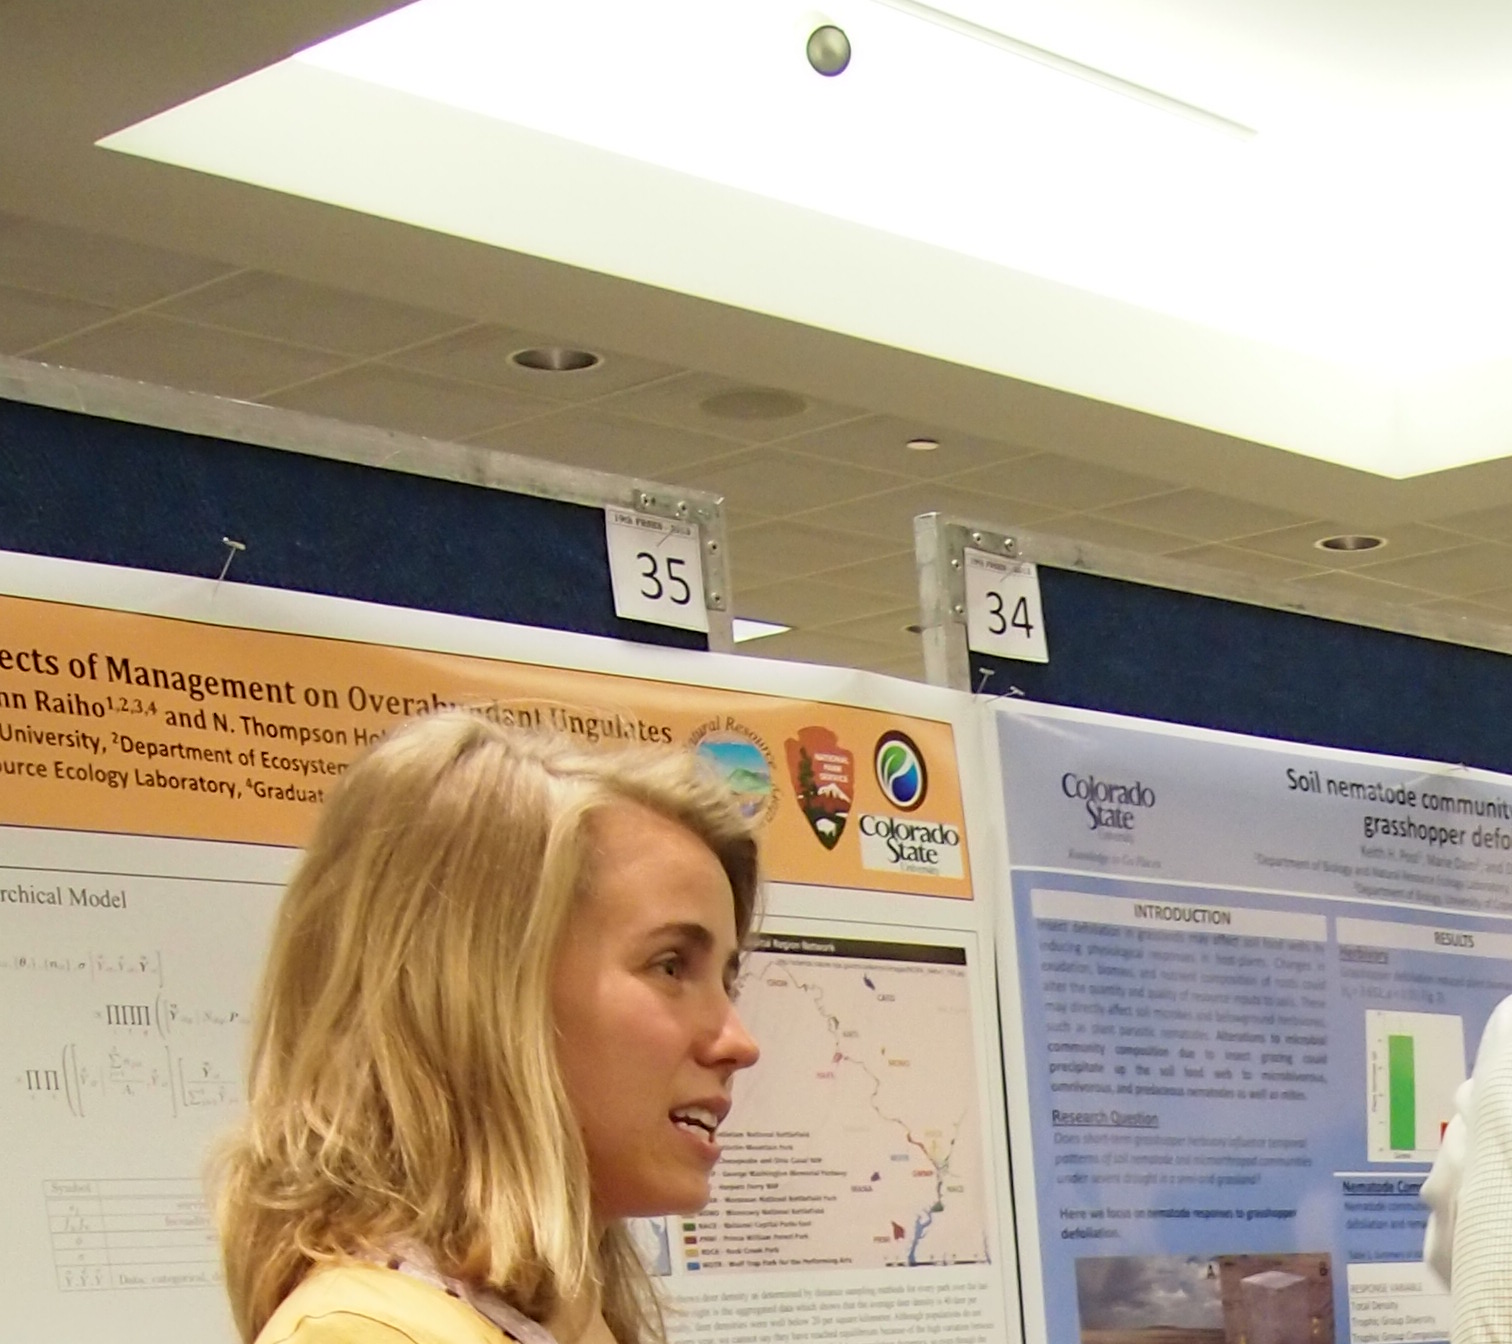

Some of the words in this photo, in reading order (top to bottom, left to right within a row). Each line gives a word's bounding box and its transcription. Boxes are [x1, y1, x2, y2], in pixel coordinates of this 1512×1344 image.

[637, 552, 691, 605] 35
[986, 592, 1034, 639] 34
[69, 653, 98, 680] of
[105, 655, 296, 705] Management
[304, 687, 340, 709] on
[165, 708, 207, 730] and
[213, 712, 235, 733] N.
[240, 715, 347, 746] Thompson
[0, 722, 107, 755] University,
[238, 749, 255, 767] of
[54, 761, 129, 789] Ecology
[134, 767, 242, 800] Laboratory,
[1062, 773, 1155, 807] Colorado
[1286, 767, 1321, 794] Soil
[1327, 776, 1417, 807] nematode
[859, 814, 959, 846] Colorado
[1086, 800, 1134, 830] State
[1363, 813, 1465, 846] grasshopper
[887, 837, 938, 864] State
[68, 887, 127, 909] Model
[1134, 903, 1231, 925] INTRODUCTION
[1434, 932, 1474, 948] RESULTS
[1052, 1109, 1108, 1125] Research
[1111, 1110, 1158, 1126] Question
